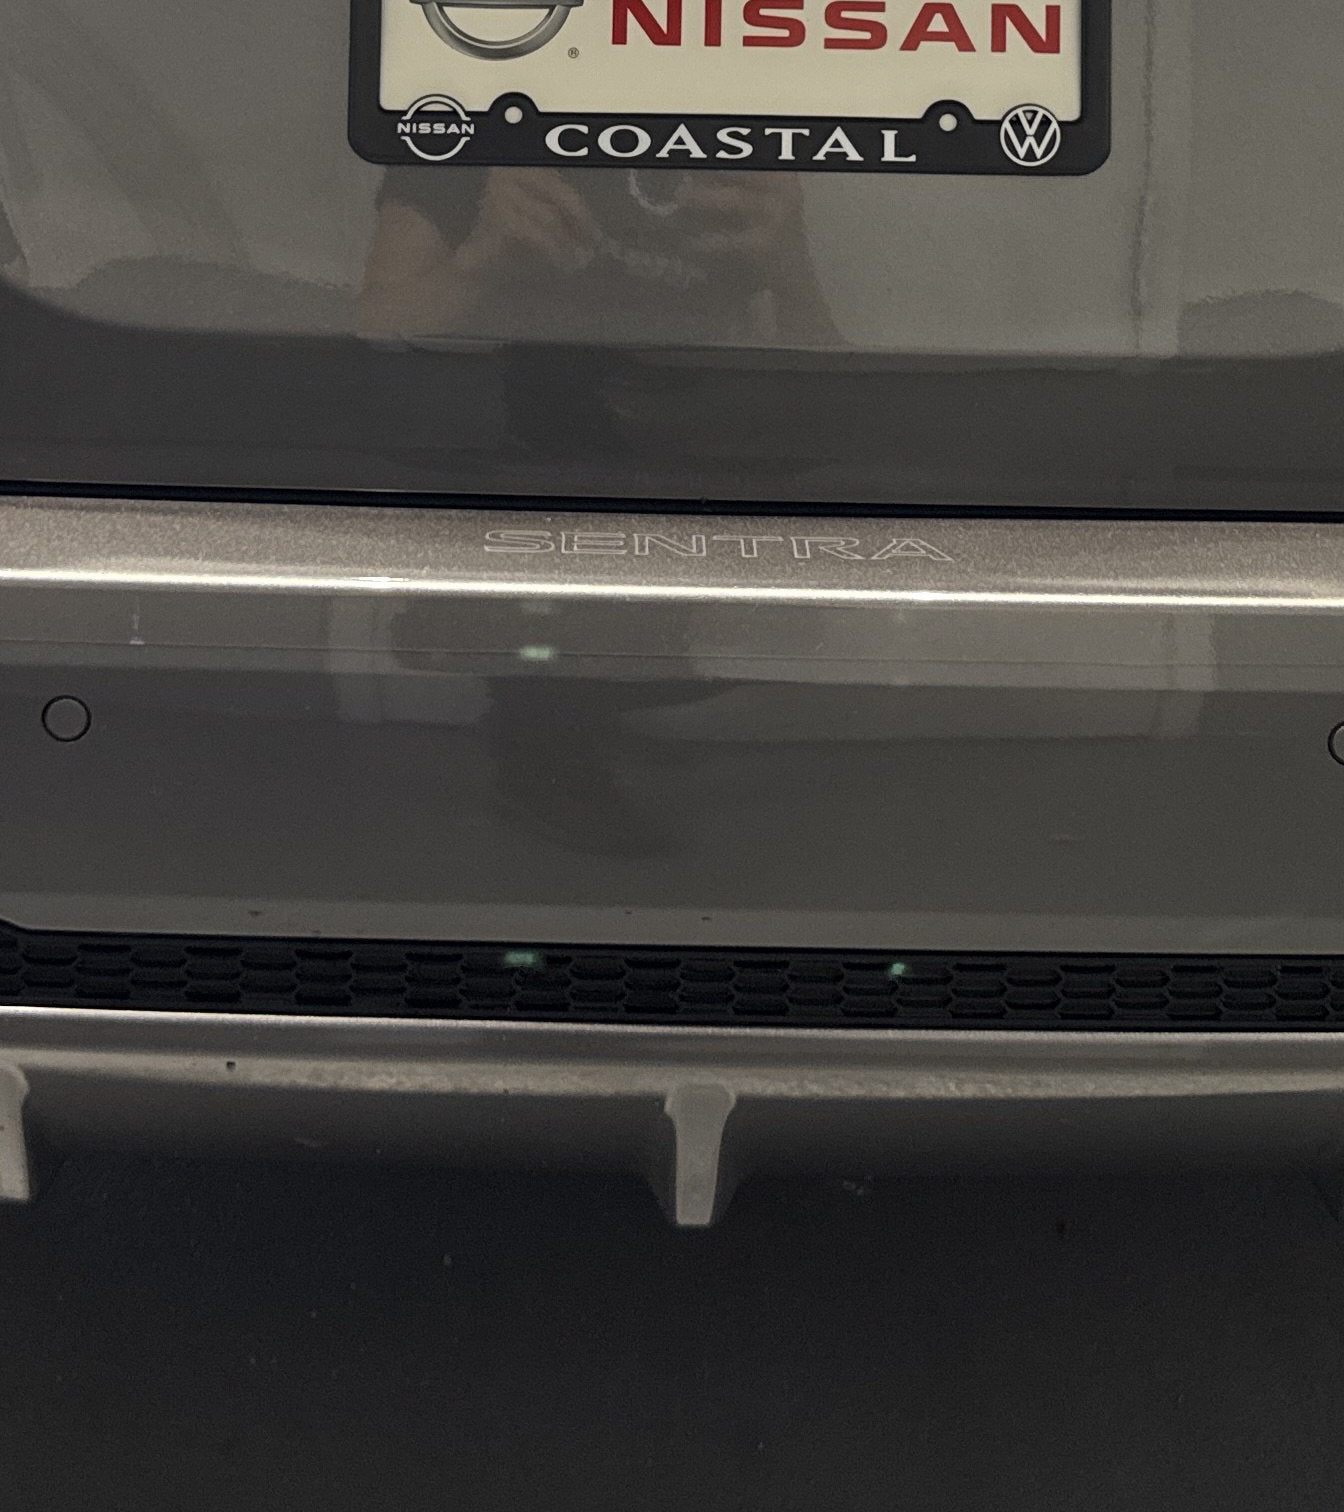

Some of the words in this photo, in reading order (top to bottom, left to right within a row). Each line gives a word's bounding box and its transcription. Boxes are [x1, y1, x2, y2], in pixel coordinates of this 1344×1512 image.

[397, 122, 475, 135] NISSAN
[545, 124, 917, 163] COASTAL
[483, 529, 954, 562] SENTRA
